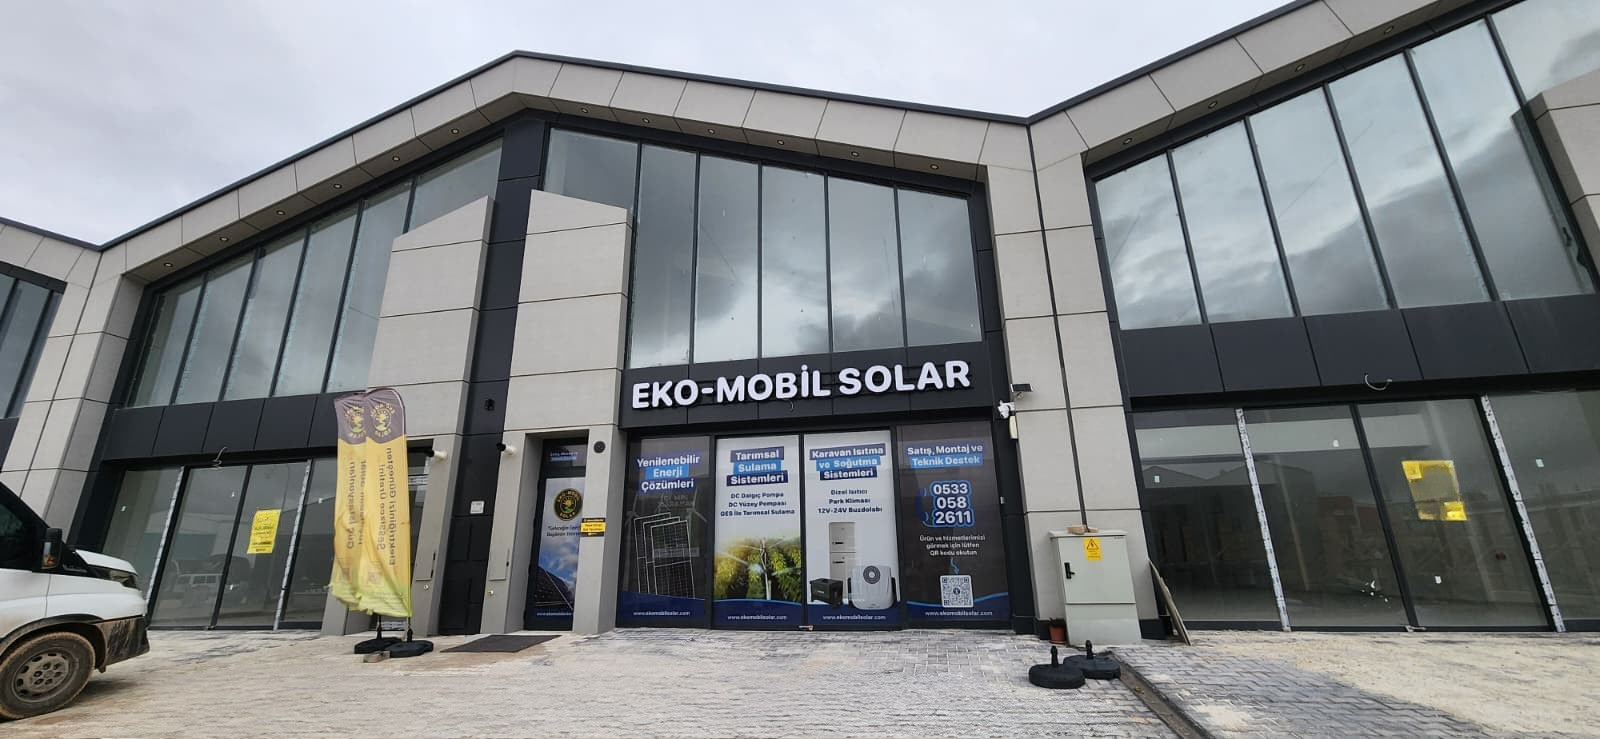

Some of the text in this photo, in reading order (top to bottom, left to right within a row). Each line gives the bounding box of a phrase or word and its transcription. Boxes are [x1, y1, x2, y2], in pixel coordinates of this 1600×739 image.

[632, 360, 971, 409] EKO-MOBİL SOLAR
[735, 450, 780, 460] Tarımsal
[812, 447, 884, 458] Karavan Isıtma
[907, 447, 935, 456] Satış,
[936, 444, 969, 454] Montaj
[637, 455, 700, 468] Yenilenebilir
[834, 459, 878, 468] Soğutma
[912, 456, 980, 466] Teknik Destek
[653, 466, 683, 478] Enerji
[738, 463, 777, 472] Sulama
[823, 468, 873, 479] Sistemleri
[731, 473, 784, 485] Sistemleri
[641, 479, 694, 493] Çözümleri
[933, 483, 968, 495] 0533
[936, 496, 967, 509] 058
[935, 511, 971, 524] 2611
